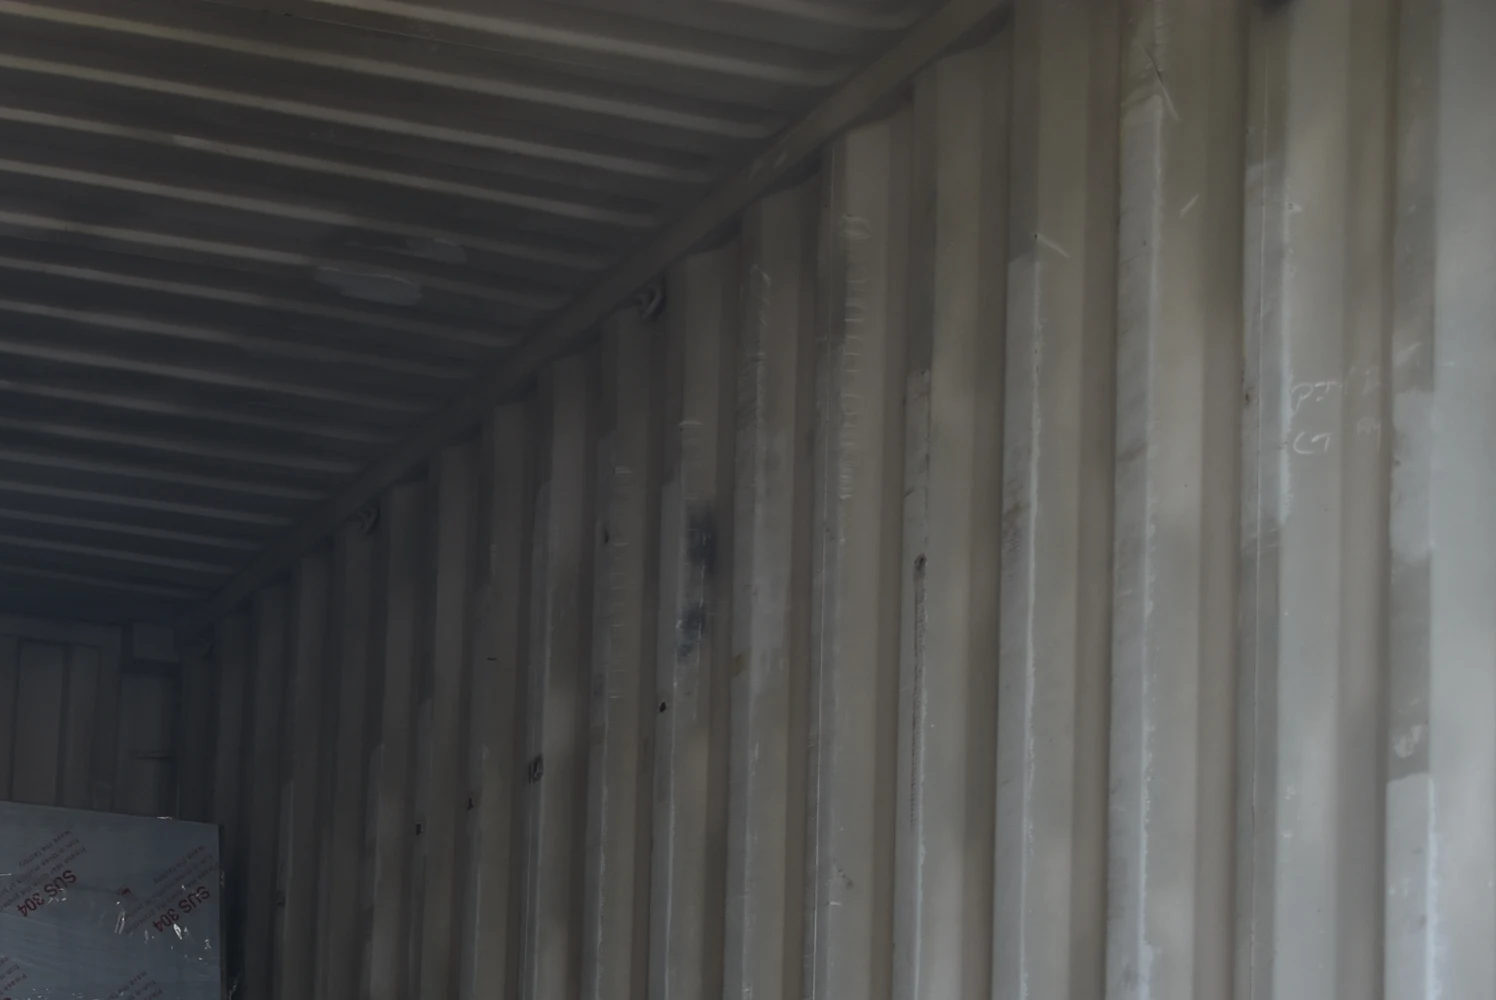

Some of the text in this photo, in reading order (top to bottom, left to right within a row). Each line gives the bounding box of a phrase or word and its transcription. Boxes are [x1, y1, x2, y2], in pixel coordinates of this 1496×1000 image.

[43, 869, 76, 897] SUS
[17, 893, 43, 916] 304
[178, 886, 209, 913] SUS
[152, 908, 179, 931] 304
